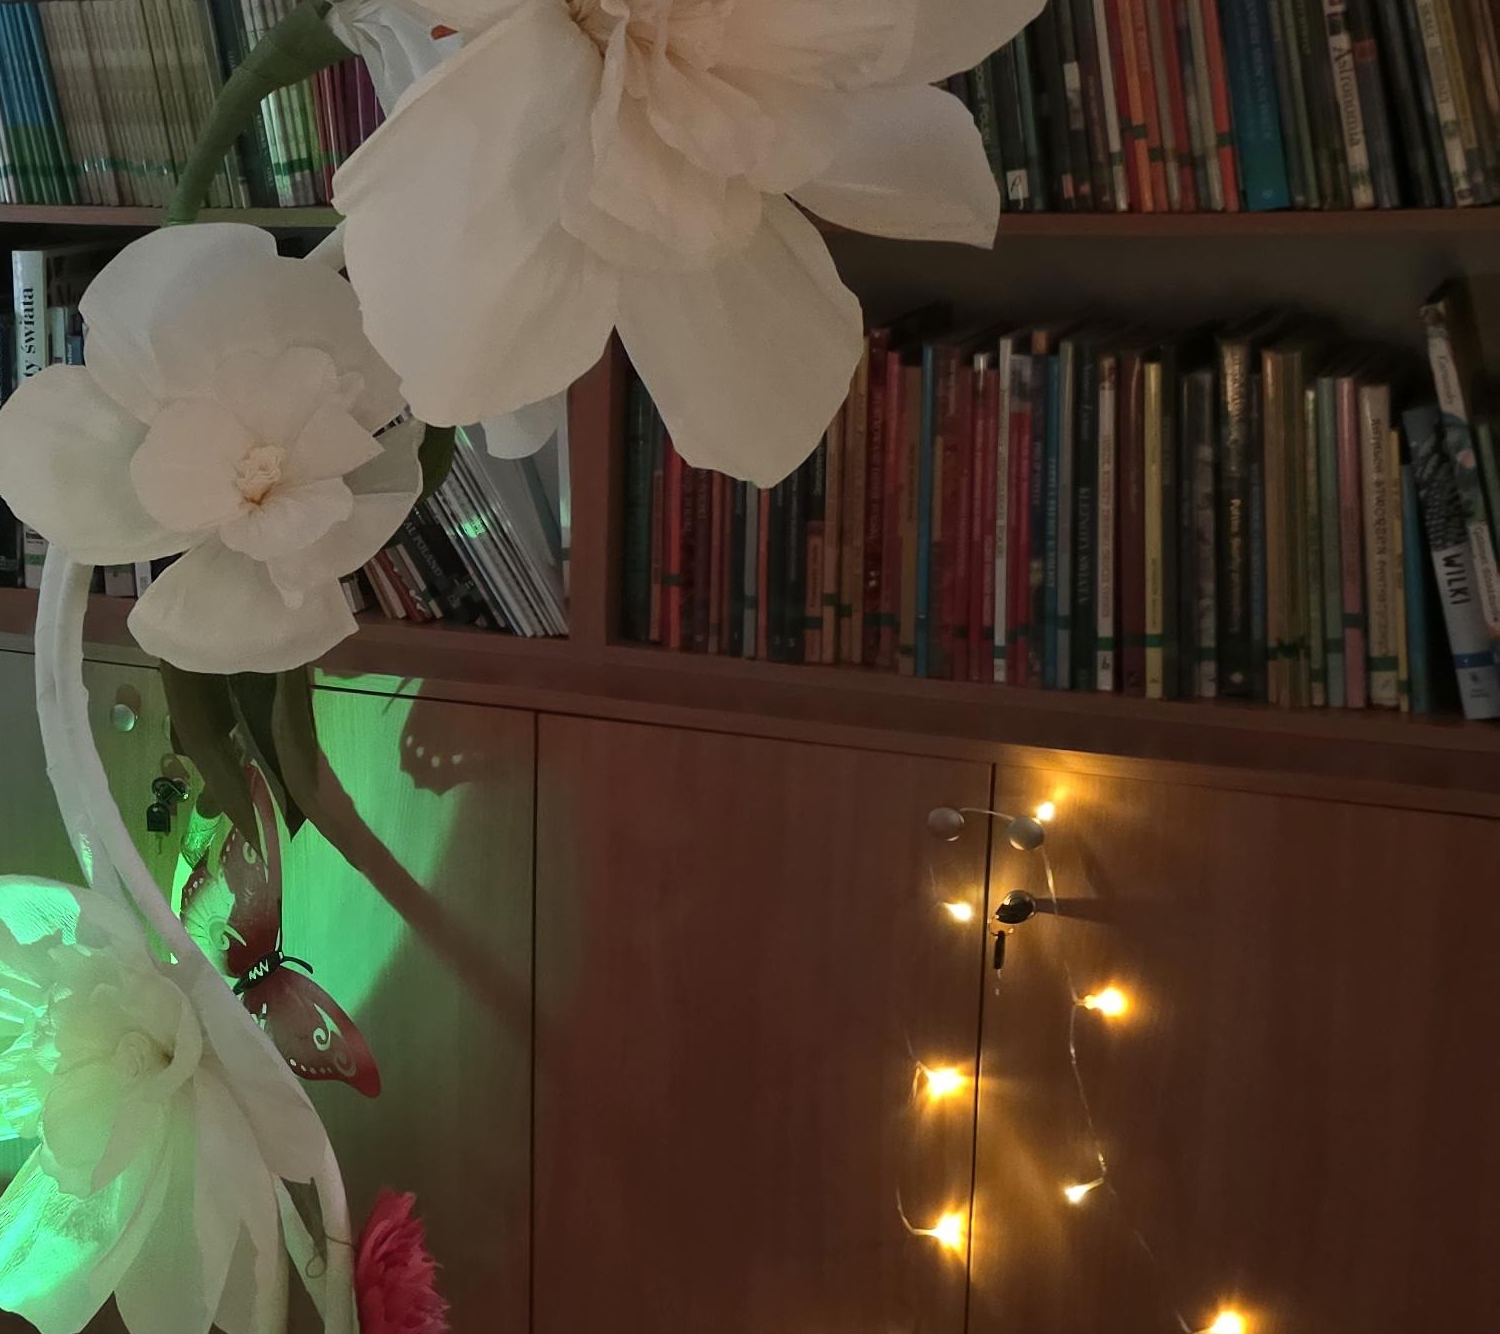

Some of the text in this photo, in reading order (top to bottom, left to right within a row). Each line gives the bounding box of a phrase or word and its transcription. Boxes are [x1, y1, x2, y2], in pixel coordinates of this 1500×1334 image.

[1332, 45, 1361, 147] Astronomia
[20, 287, 37, 355] świata
[1443, 553, 1471, 606] WILKI
